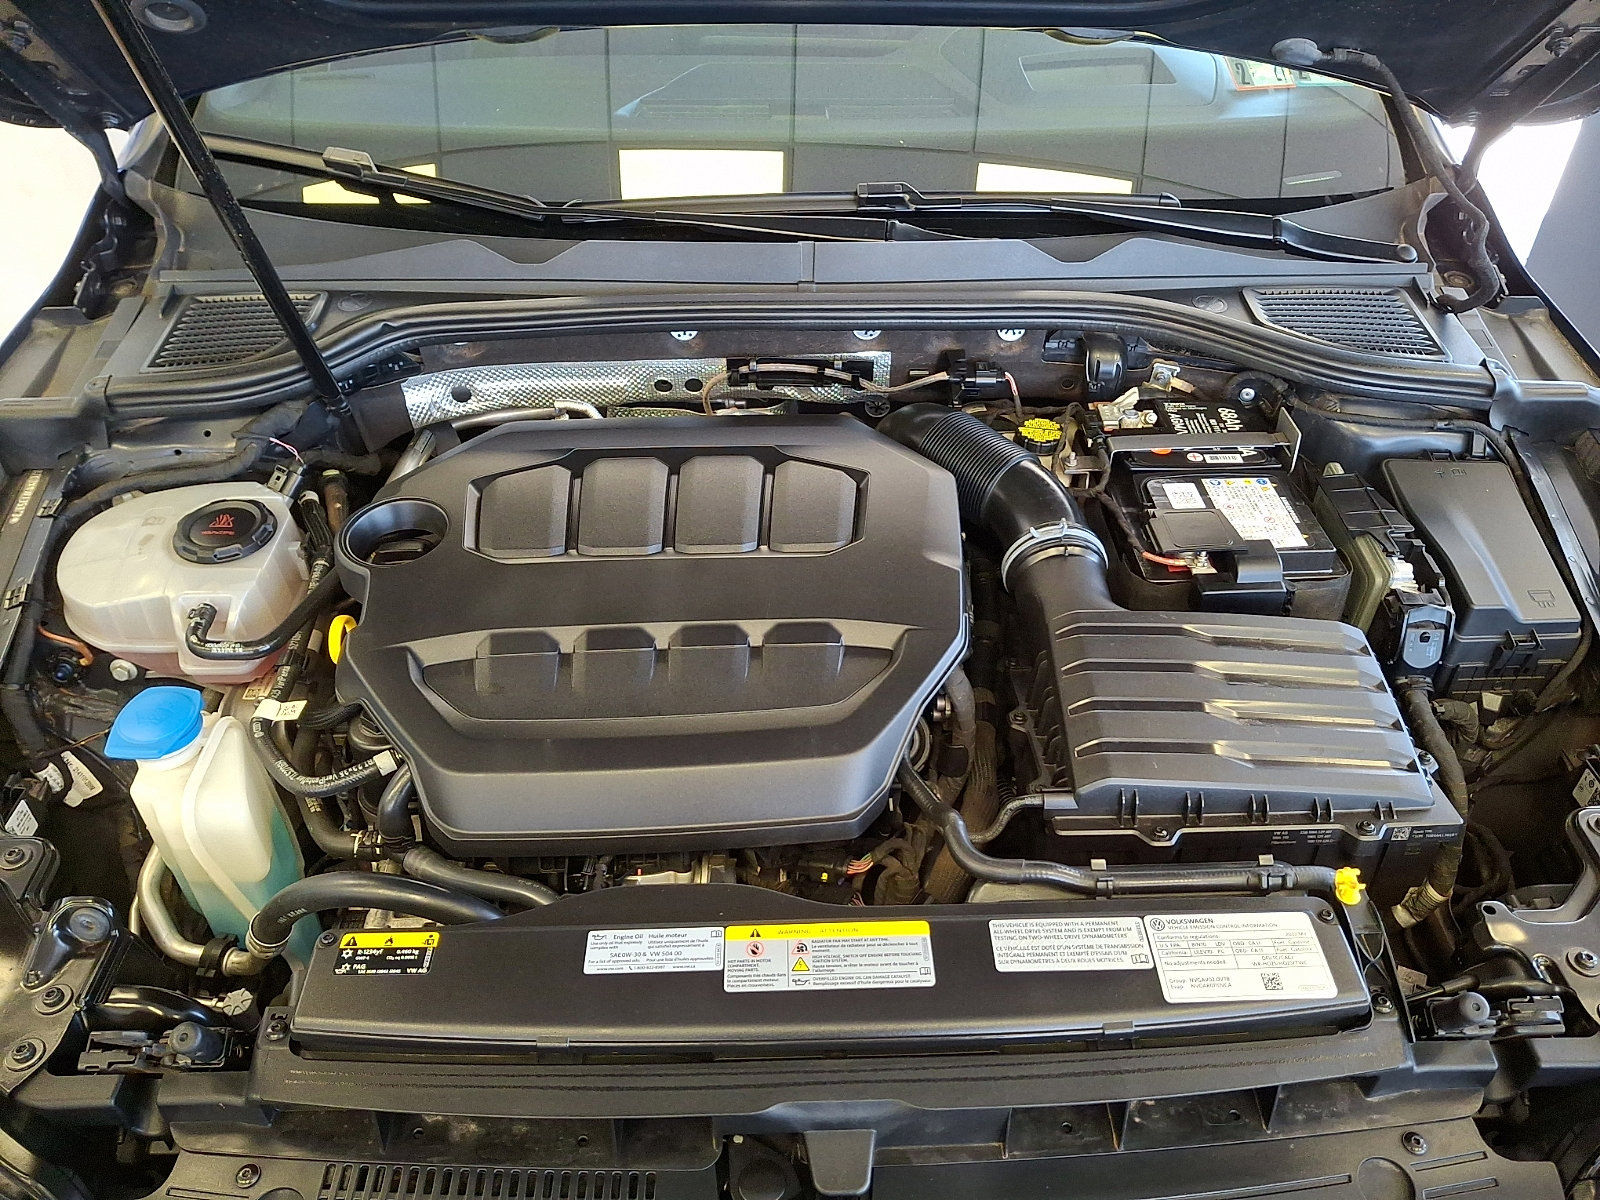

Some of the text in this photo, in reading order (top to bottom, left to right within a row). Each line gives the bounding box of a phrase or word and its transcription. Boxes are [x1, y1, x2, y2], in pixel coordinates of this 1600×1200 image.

[1235, 62, 1250, 85] 2
[1218, 407, 1243, 431] 68Ah
[357, 948, 384, 956] R-1234yf
